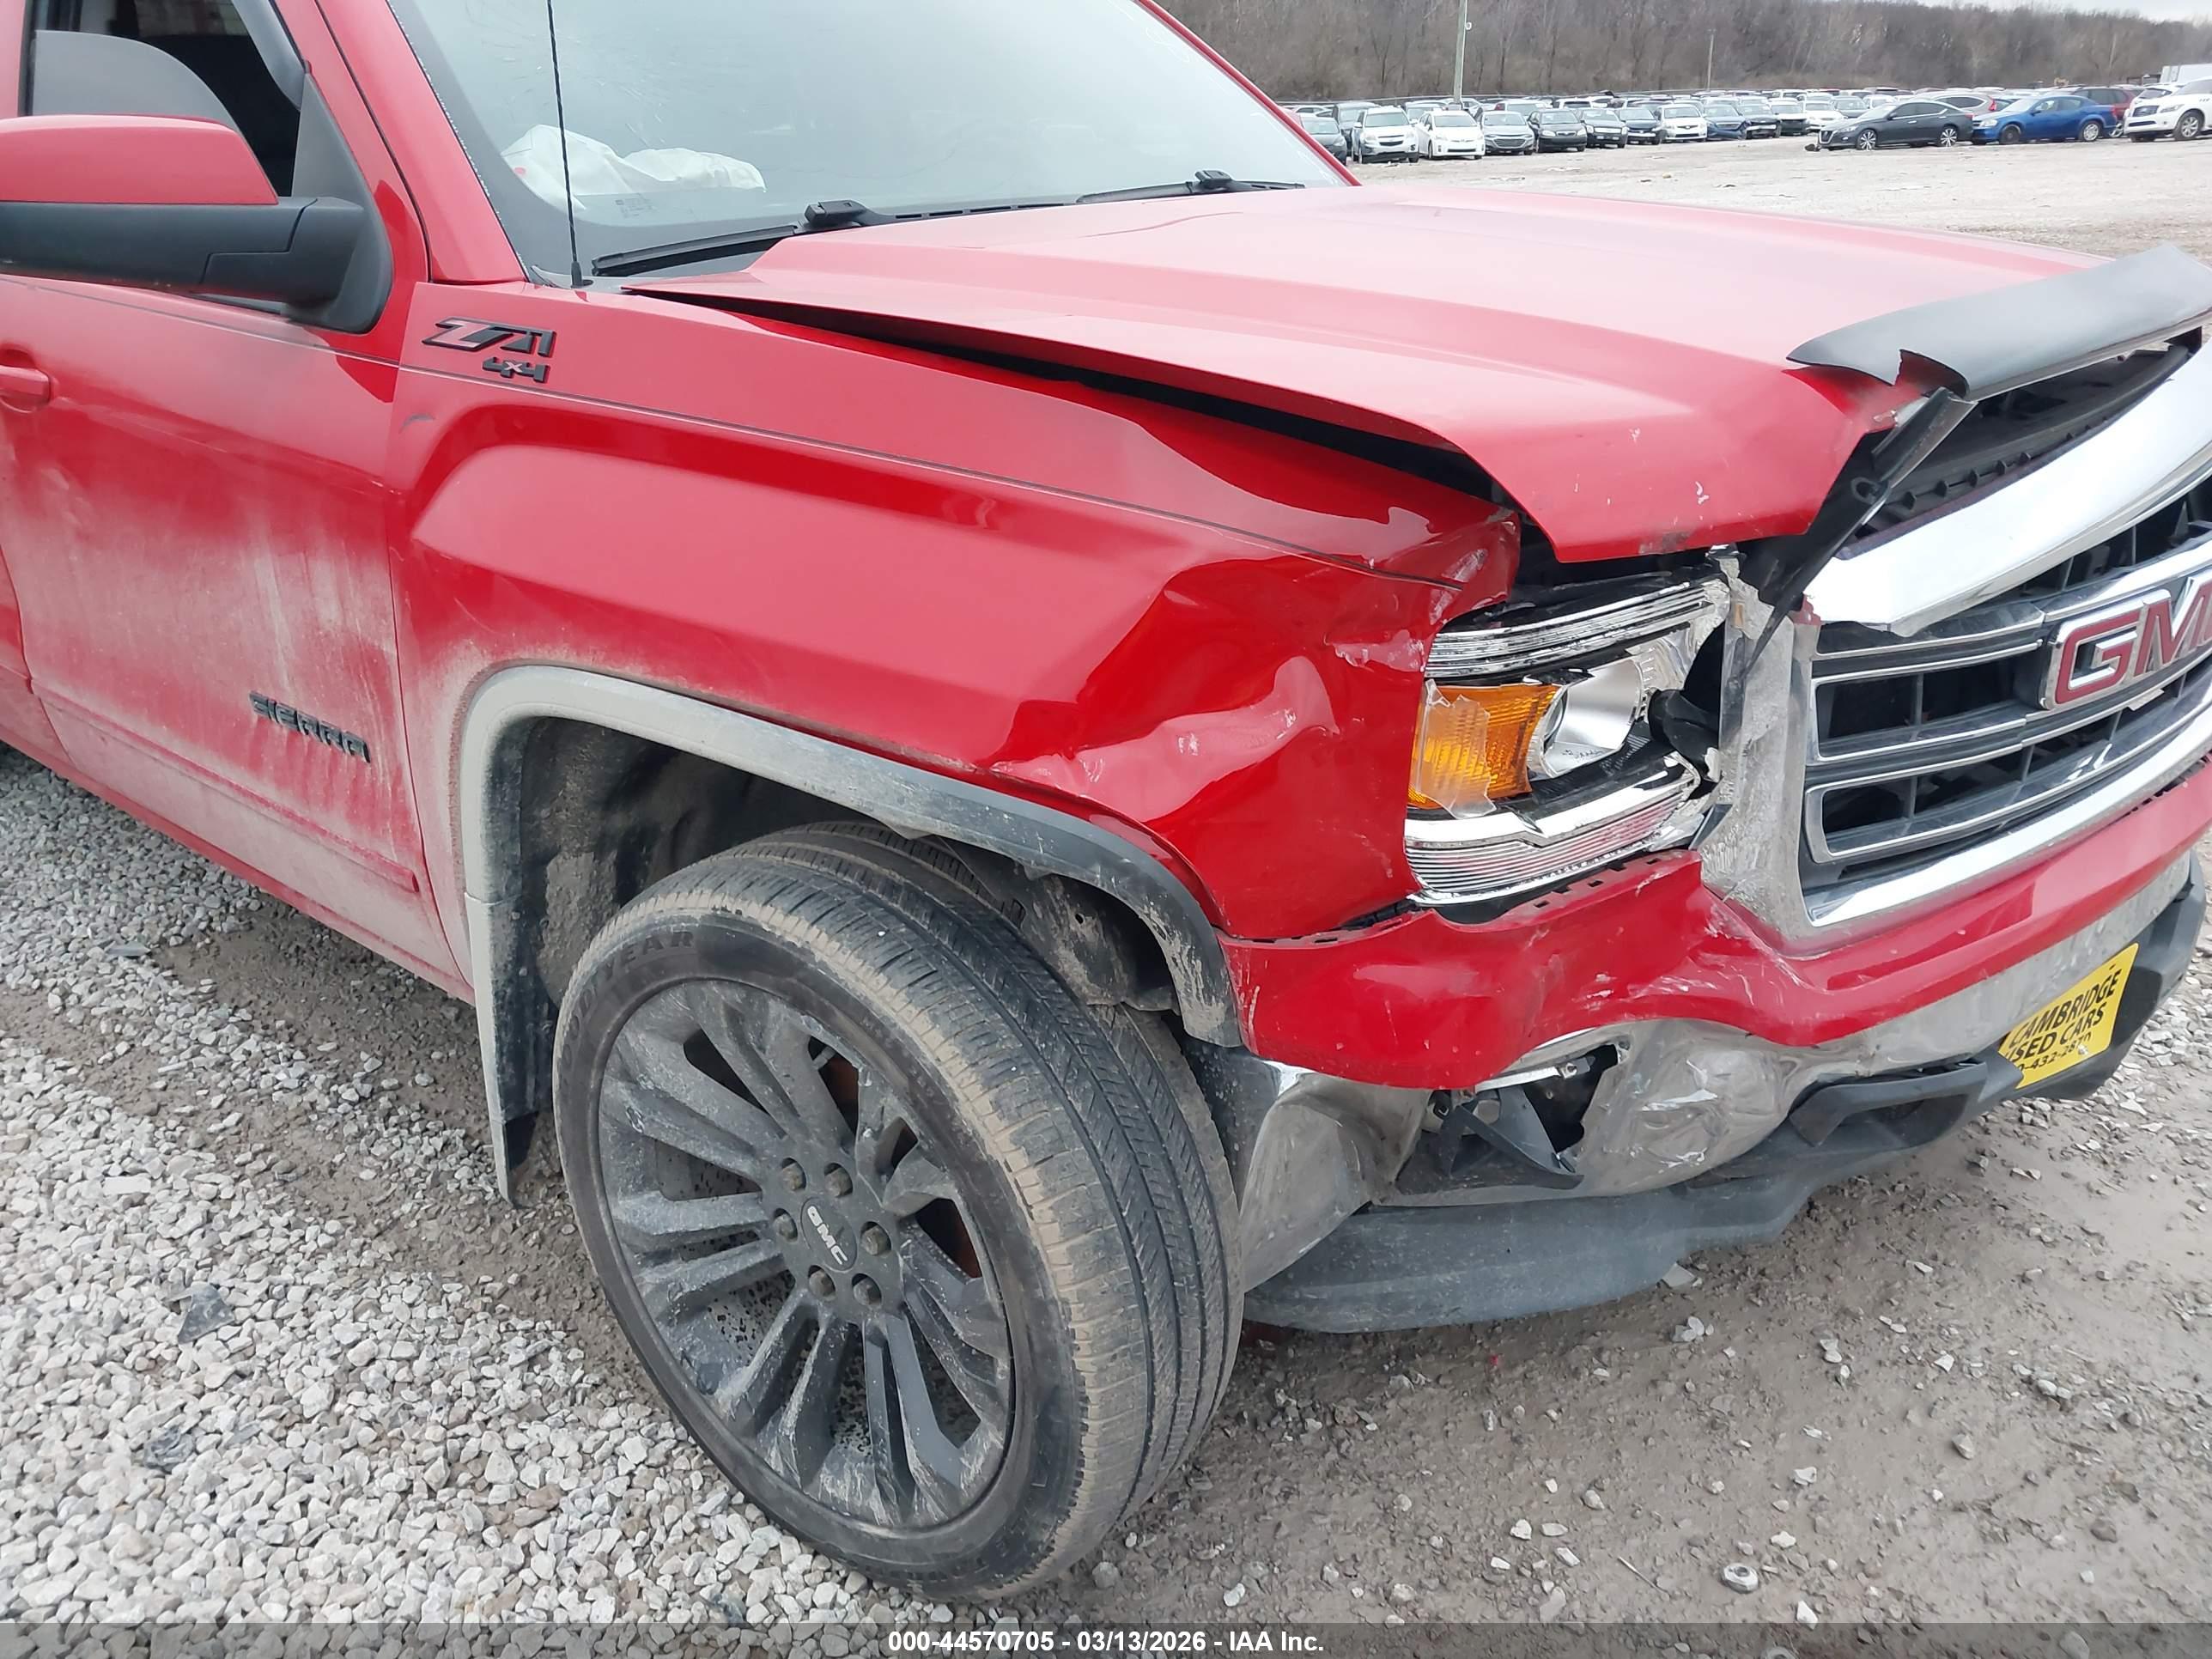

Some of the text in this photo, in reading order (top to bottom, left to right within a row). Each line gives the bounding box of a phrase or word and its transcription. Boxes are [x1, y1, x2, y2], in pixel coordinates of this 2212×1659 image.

[422, 316, 557, 358] Z71
[248, 690, 371, 763] SIERRA
[2008, 967, 2123, 1049] CAMBRIDGE
[2059, 1001, 2107, 1045] CARS
[807, 1205, 848, 1266] GMC
